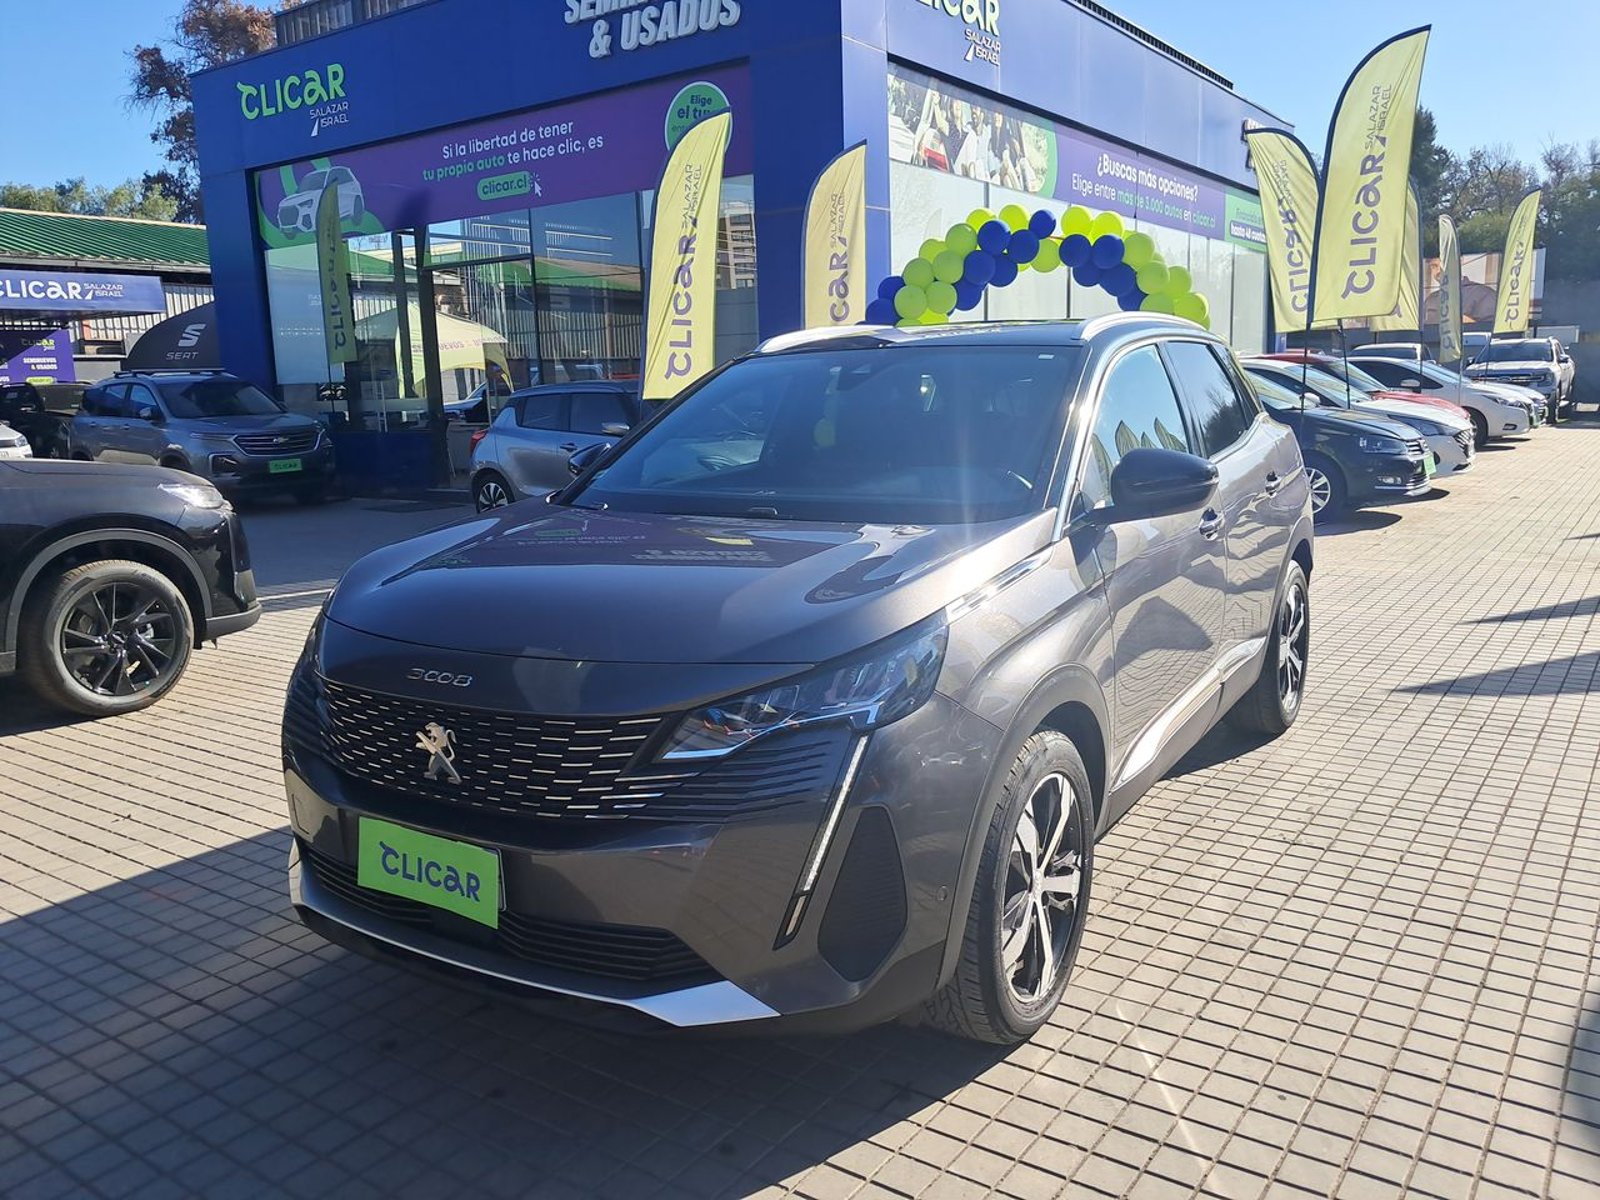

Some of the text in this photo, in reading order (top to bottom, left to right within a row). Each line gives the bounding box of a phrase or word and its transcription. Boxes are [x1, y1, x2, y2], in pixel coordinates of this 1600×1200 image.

[589, 20, 611, 58] &
[621, 0, 741, 50] USADOS
[964, 28, 1000, 53] SALAZAR
[309, 101, 349, 119] SALAZAR
[320, 116, 349, 128] ISRAEL
[677, 105, 690, 119] el
[1364, 85, 1382, 150] SALAZAR
[1376, 84, 1392, 137] ISRAEL
[422, 135, 604, 182] tu propio auto te hace clic, es
[442, 121, 574, 159] Si la libertad de tener
[481, 174, 528, 196] clicar.cl
[681, 164, 693, 230] SALAZAR
[1097, 153, 1198, 203] ¿Buscas más opciones?
[1072, 173, 1093, 197] Elige
[1094, 183, 1116, 201] entre
[1183, 209, 1192, 223] en
[0, 279, 82, 300] LICaR
[406, 668, 473, 687] 3008
